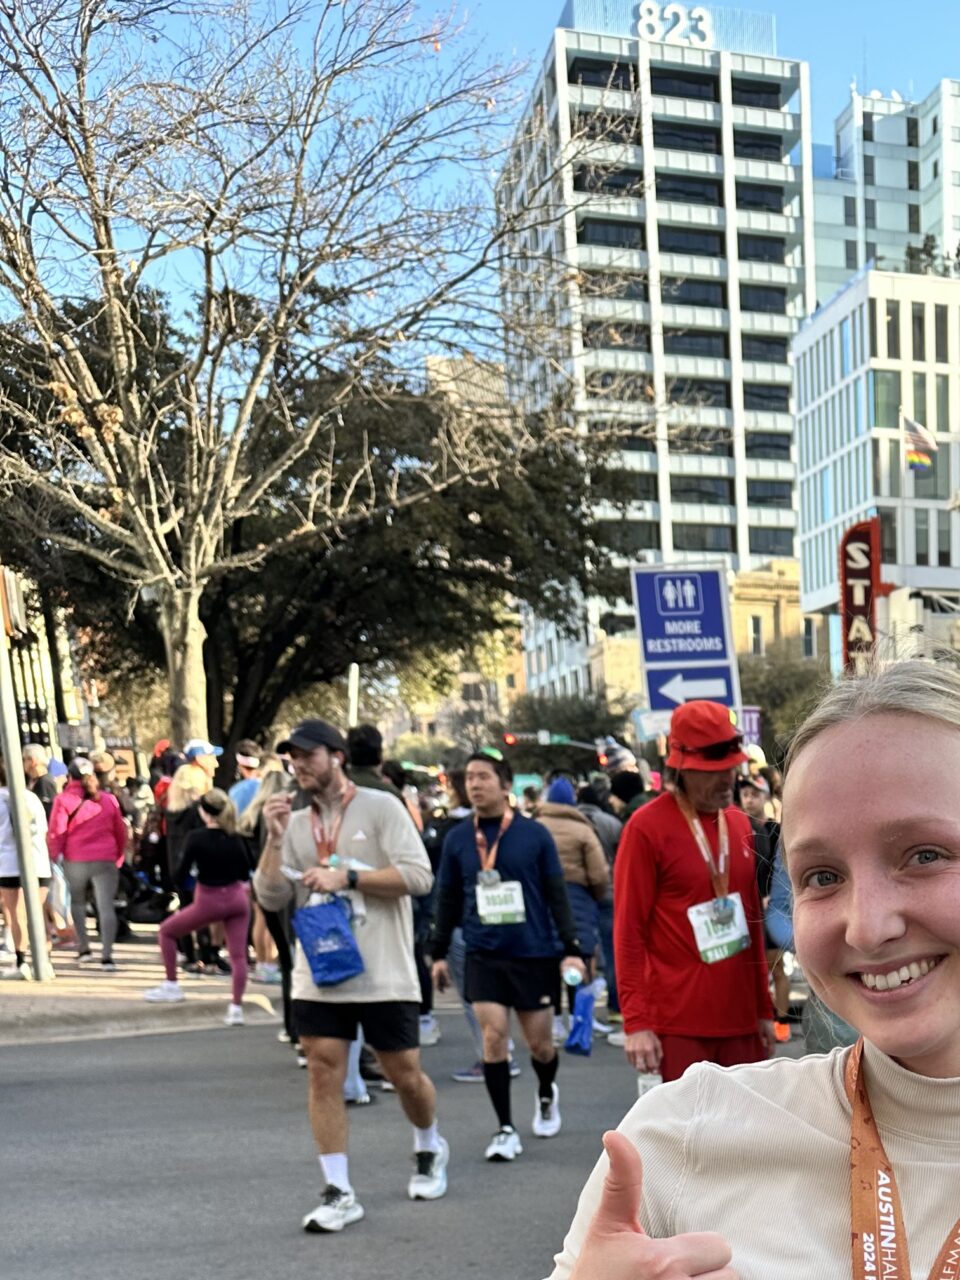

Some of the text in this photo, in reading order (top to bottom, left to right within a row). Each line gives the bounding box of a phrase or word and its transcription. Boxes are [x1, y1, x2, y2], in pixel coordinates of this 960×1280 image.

[633, 0, 715, 48] 823
[664, 620, 703, 635] MORE
[846, 541, 875, 678] STAT
[646, 636, 724, 653] RESTROOMS
[862, 1232, 877, 1272] 2024
